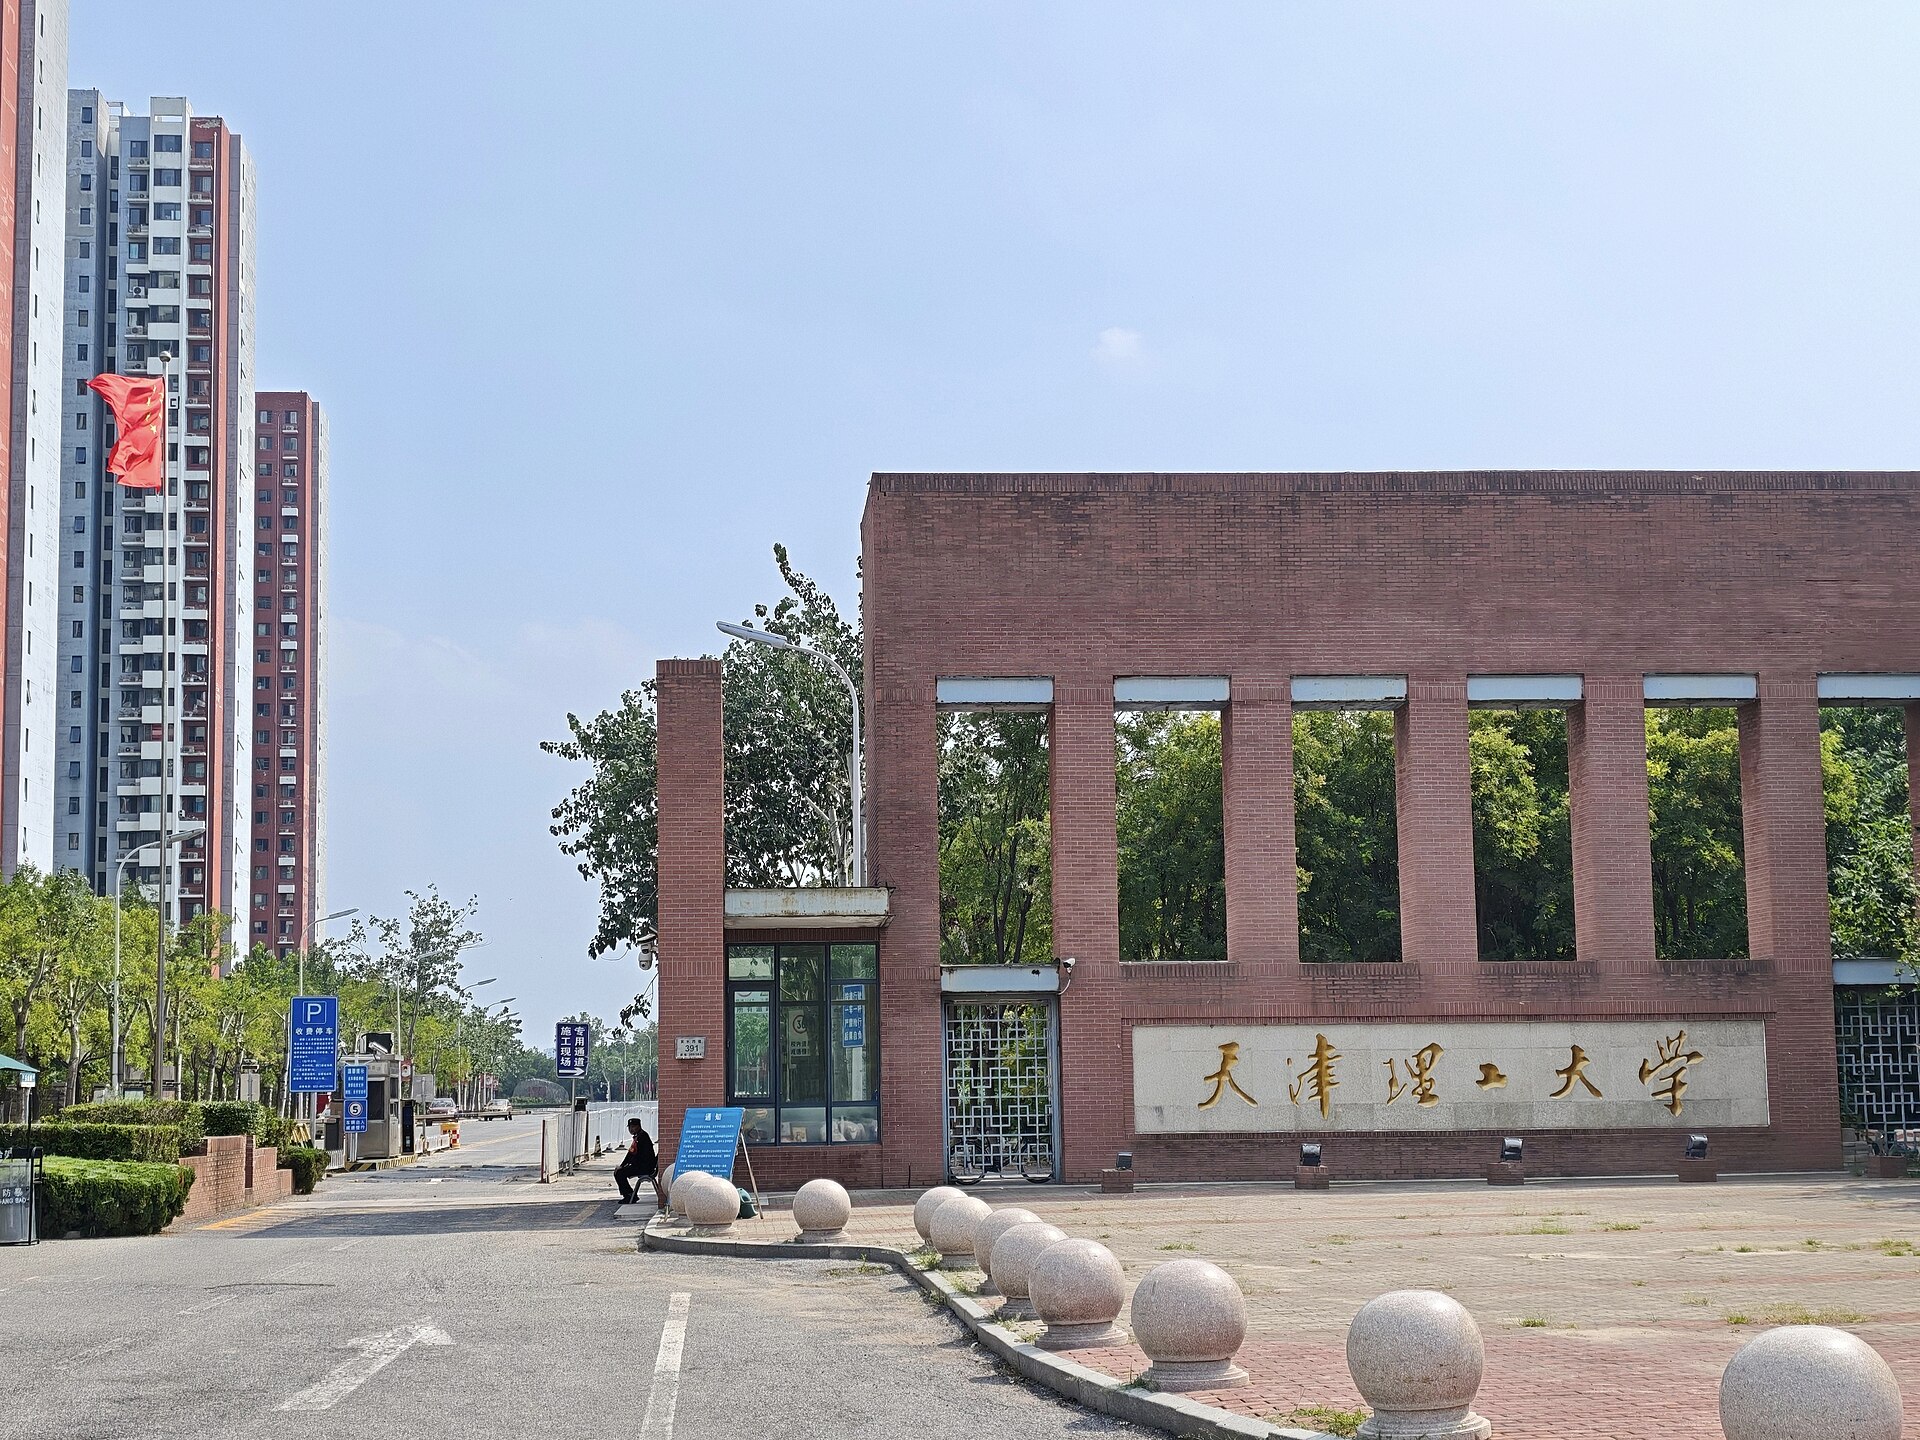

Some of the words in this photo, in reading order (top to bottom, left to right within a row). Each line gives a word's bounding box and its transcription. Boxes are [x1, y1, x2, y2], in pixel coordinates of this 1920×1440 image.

[295, 1027, 333, 1036] 收费停车
[560, 1026, 572, 1067] 施工现场
[573, 1026, 585, 1067] 专用通道
[1198, 1030, 1704, 1119] 天津理工大学
